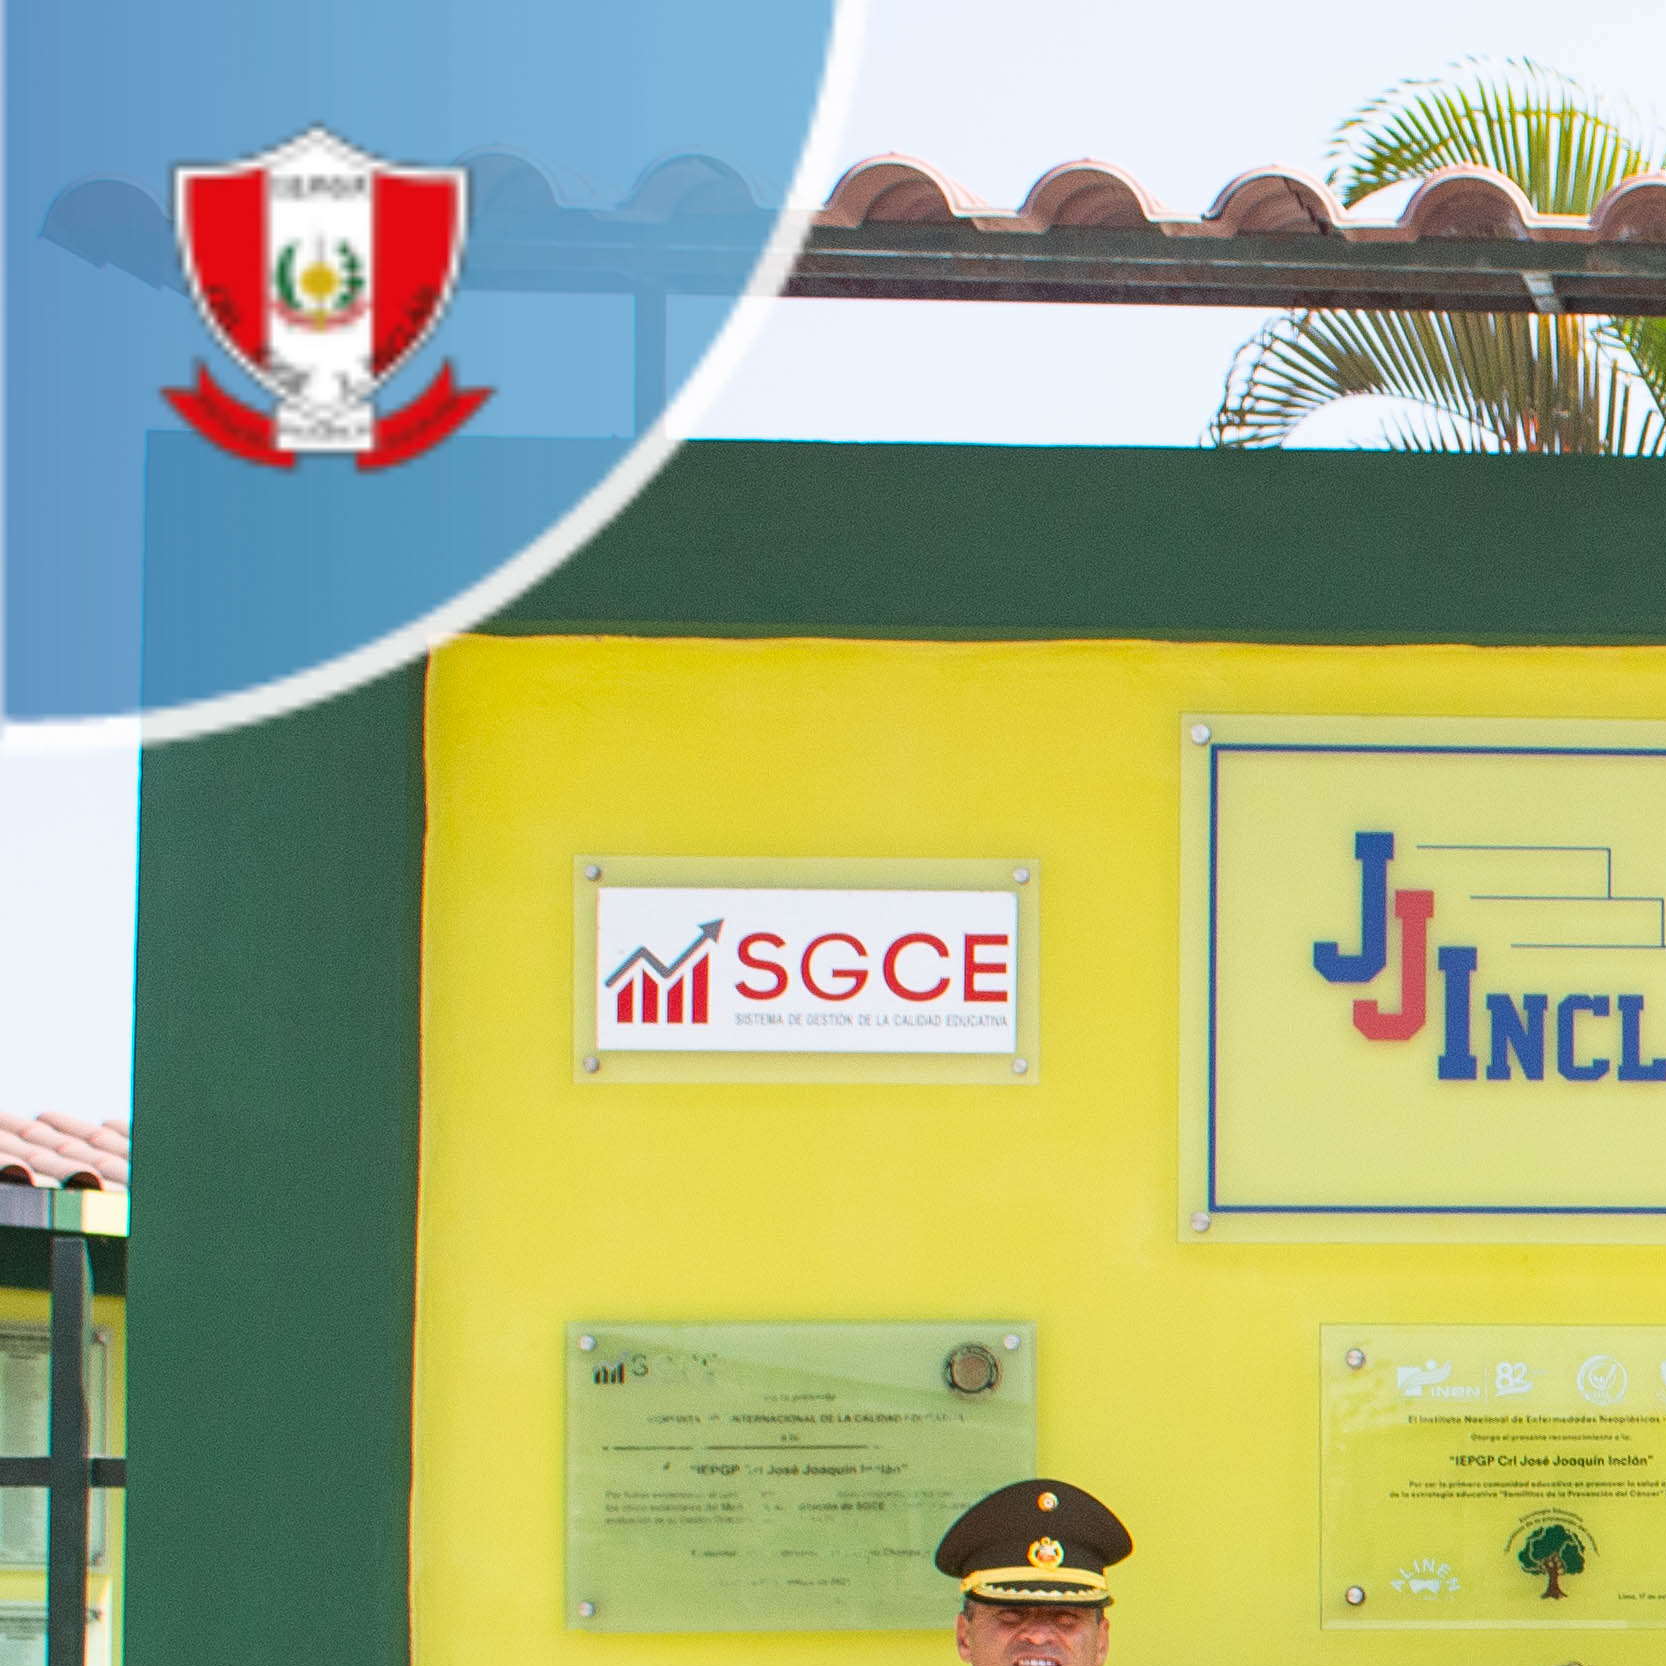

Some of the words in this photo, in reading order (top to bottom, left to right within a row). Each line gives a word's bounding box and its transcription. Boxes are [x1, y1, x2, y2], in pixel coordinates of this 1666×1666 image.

[735, 932, 1009, 1003] SGCE
[734, 1012, 783, 1026] SISTEMA
[789, 1012, 804, 1026] DE
[858, 1012, 872, 1026] DE
[877, 1012, 890, 1026] LA
[895, 1012, 941, 1026] CALIDAD
[946, 1012, 1009, 1026] EDUCATIVA
[1519, 1454, 1550, 1466] José
